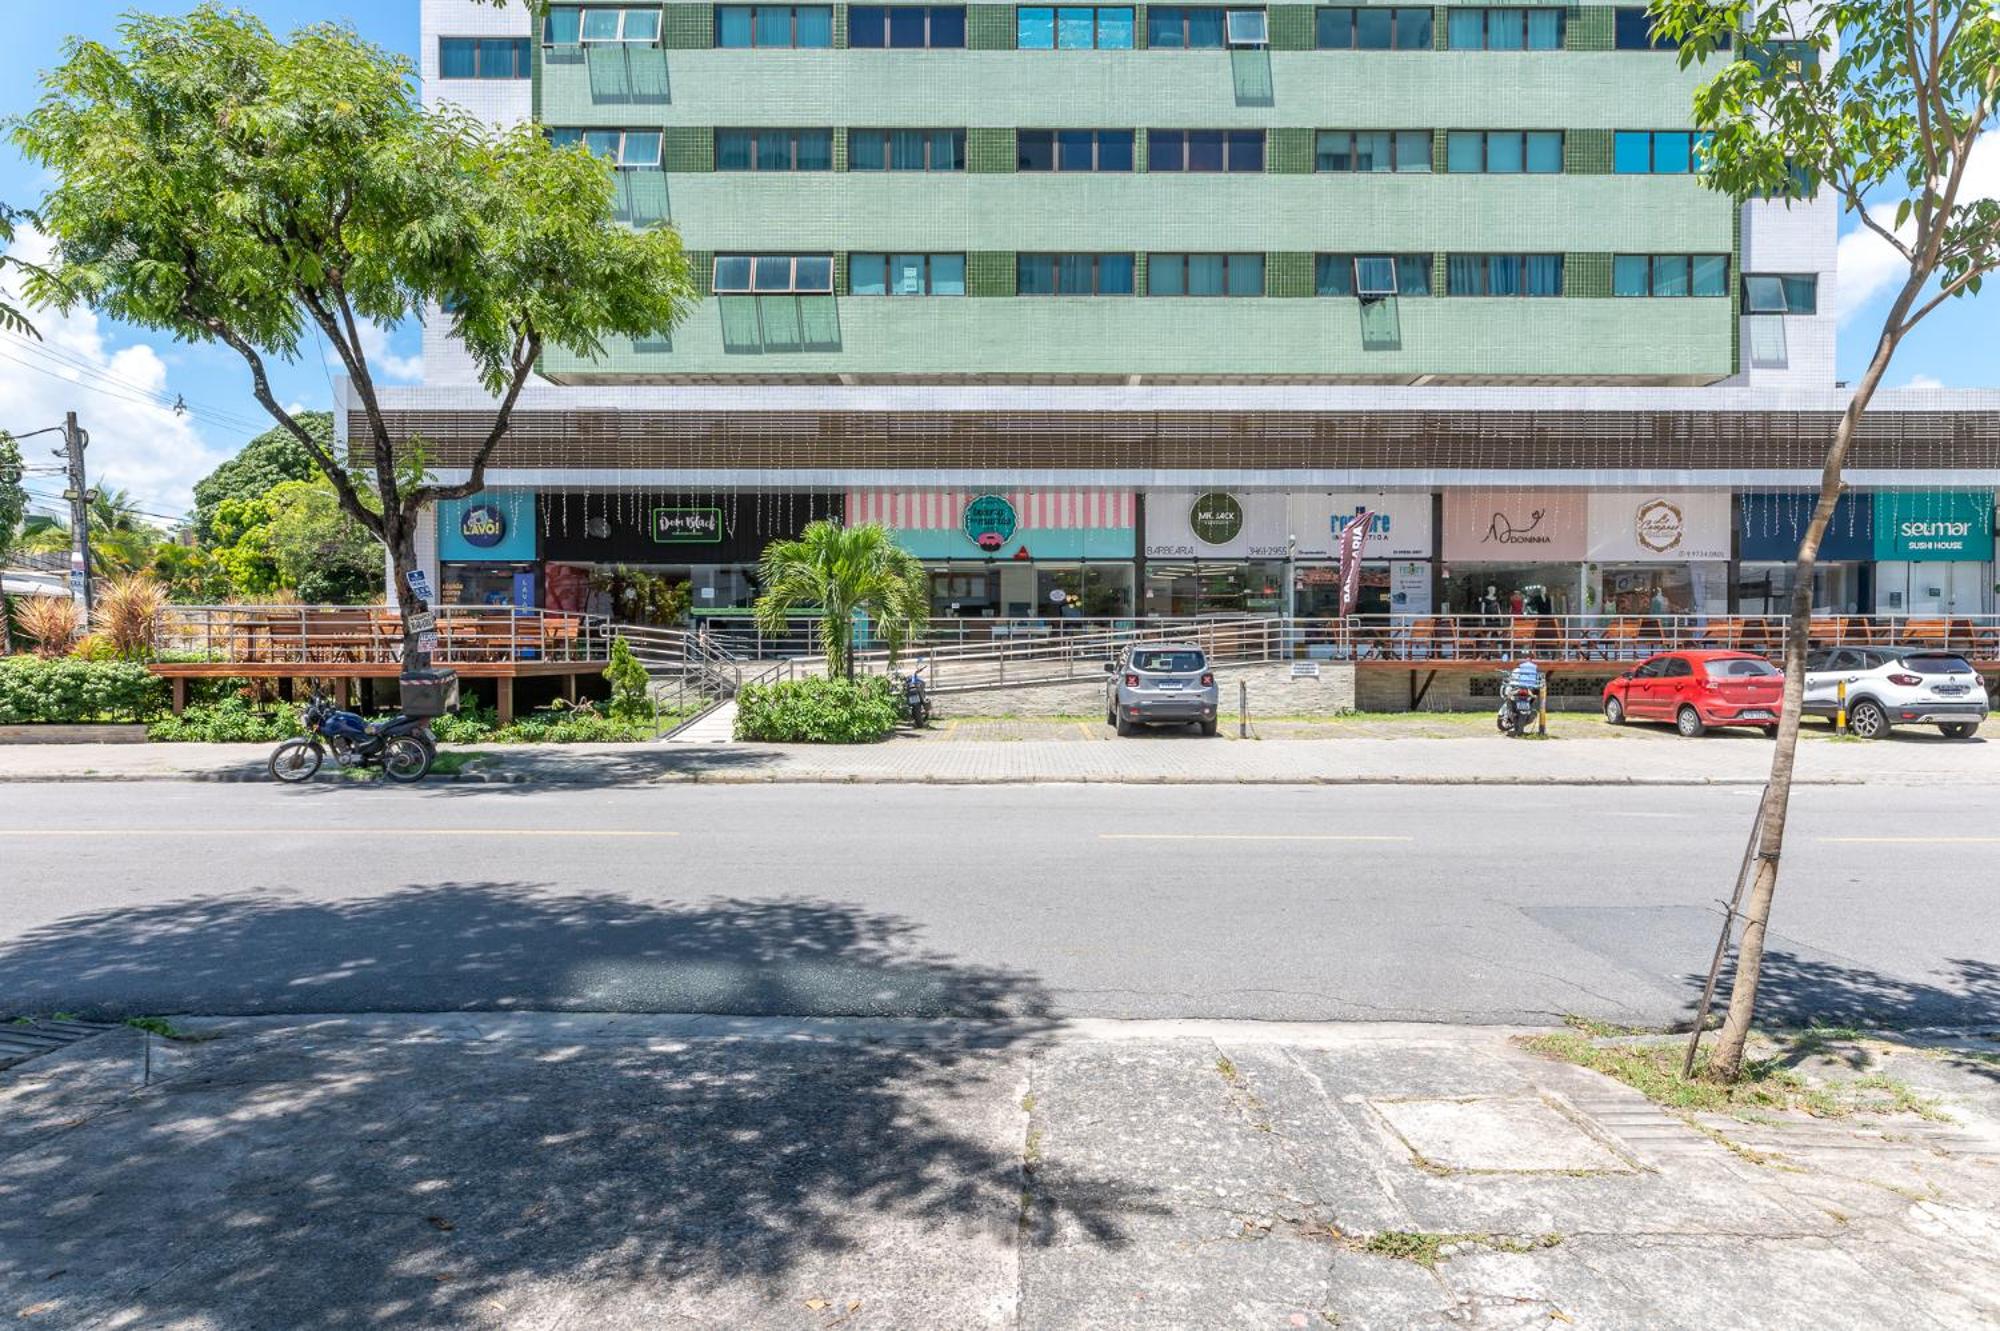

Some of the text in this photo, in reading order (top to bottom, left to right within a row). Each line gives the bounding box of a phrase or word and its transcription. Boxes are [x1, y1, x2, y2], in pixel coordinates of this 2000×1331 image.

[1215, 512, 1235, 520] JACK
[659, 513, 716, 531] Dom Black
[1908, 541, 1964, 550] SUSHI HOUSE
[1146, 546, 1194, 556] BARBEARIA
[1249, 546, 1288, 556] 3461-2955
[1343, 526, 1363, 603] BAARIA
